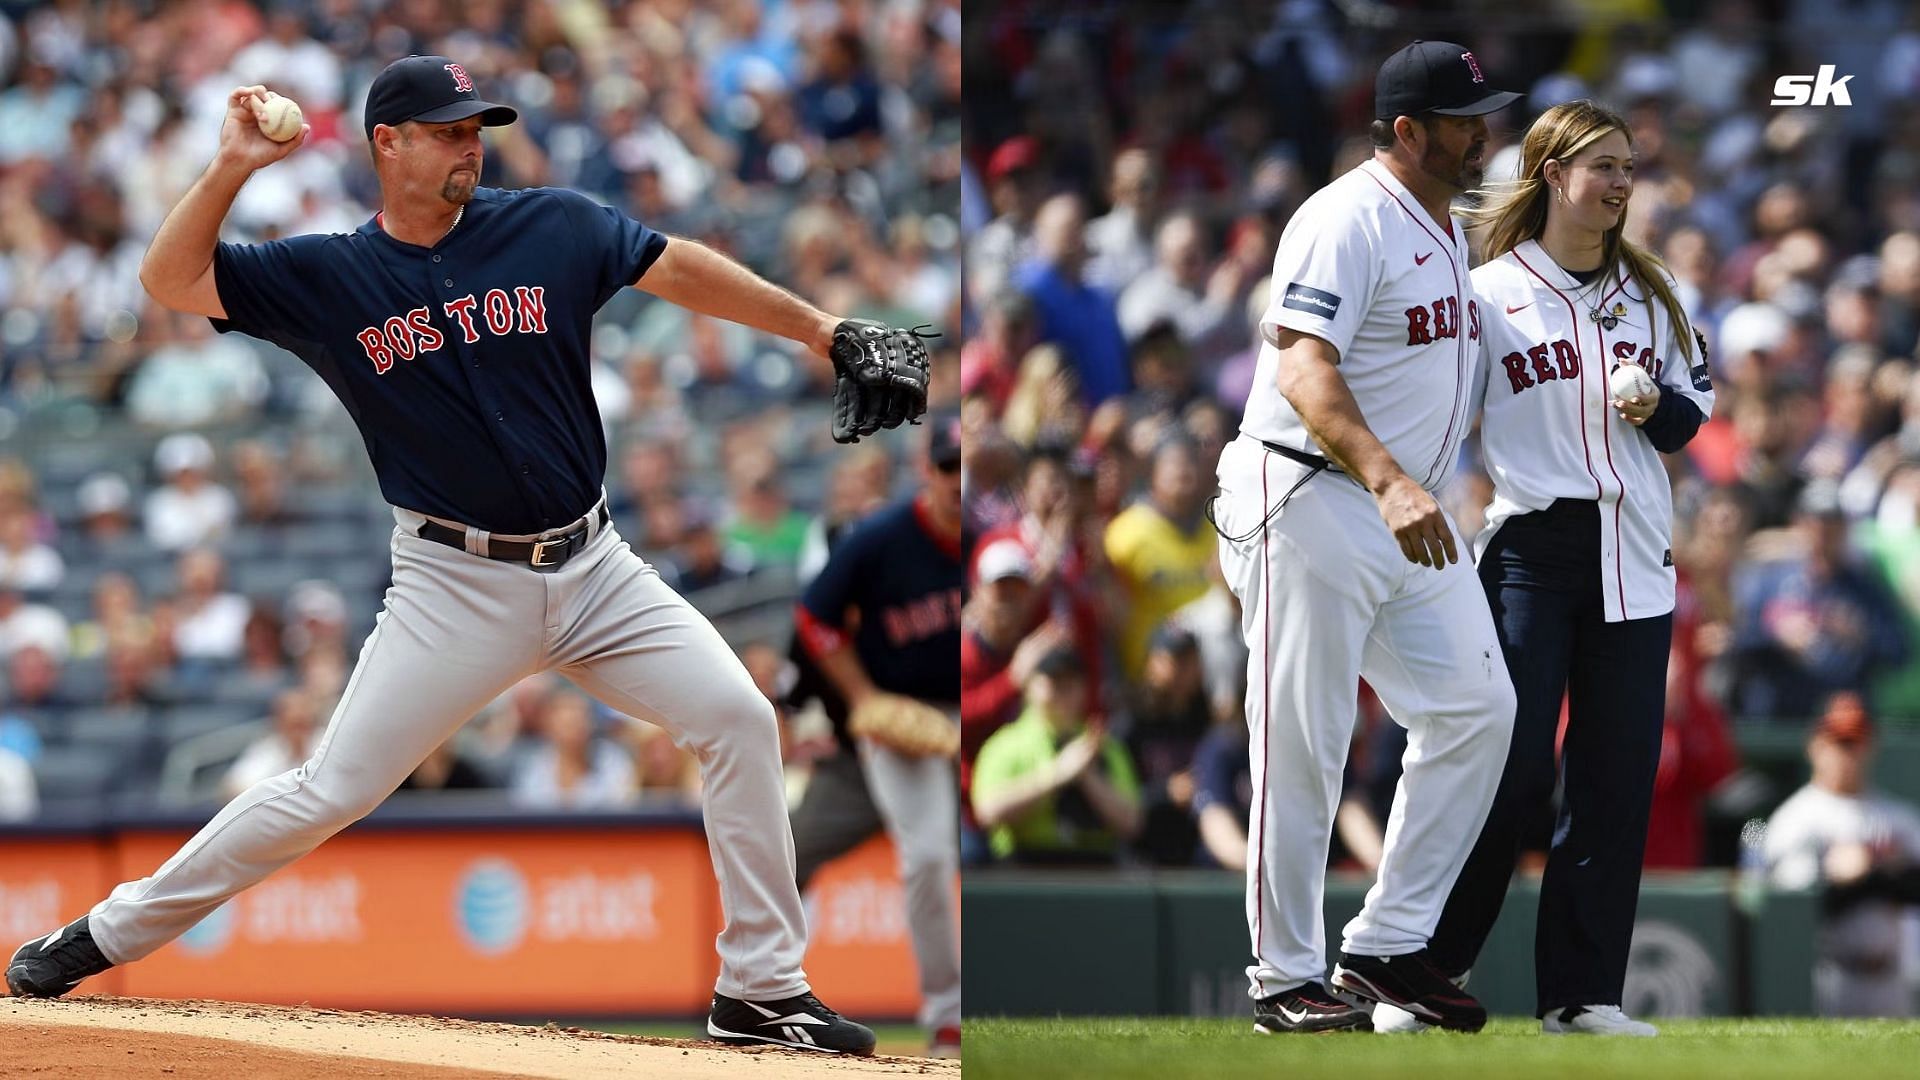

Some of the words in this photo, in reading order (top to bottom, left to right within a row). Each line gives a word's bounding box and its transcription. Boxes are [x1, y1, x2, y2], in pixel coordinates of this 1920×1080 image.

[444, 63, 473, 92] B
[356, 286, 548, 375] BOSTON
[1404, 295, 1459, 346] RED
[1501, 339, 1580, 394] RED
